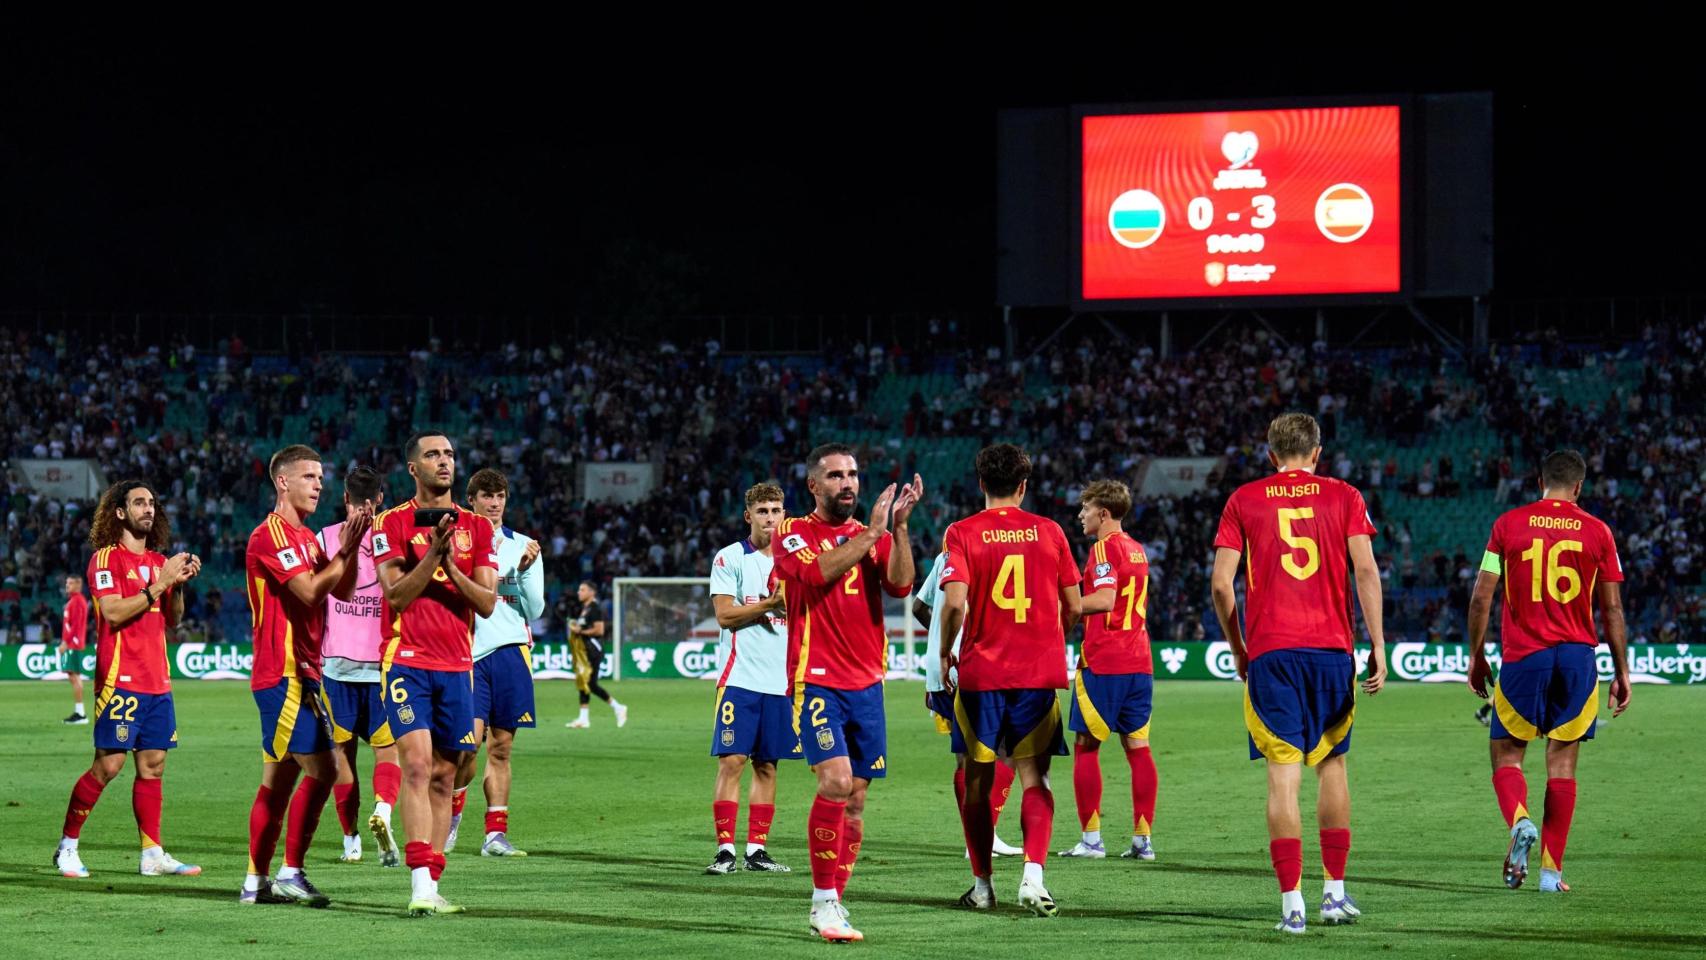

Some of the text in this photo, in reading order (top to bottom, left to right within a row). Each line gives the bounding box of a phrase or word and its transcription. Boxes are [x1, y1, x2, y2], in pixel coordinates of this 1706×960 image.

[1187, 196, 1214, 231] 0
[1250, 194, 1276, 229] 3
[1265, 483, 1320, 498] HUIJSEN
[982, 524, 1039, 543] CUBARSÍ
[1529, 515, 1582, 531] RODRIGO
[1277, 506, 1319, 581] 5
[844, 566, 859, 595] 2
[1521, 538, 1583, 604] 16
[991, 554, 1032, 623] 4
[335, 602, 382, 618] QUALIFIE
[176, 642, 254, 678] Carlsbe
[390, 677, 408, 704] 6
[109, 694, 138, 722] 22
[721, 701, 735, 725] 8
[808, 697, 828, 727] 2
